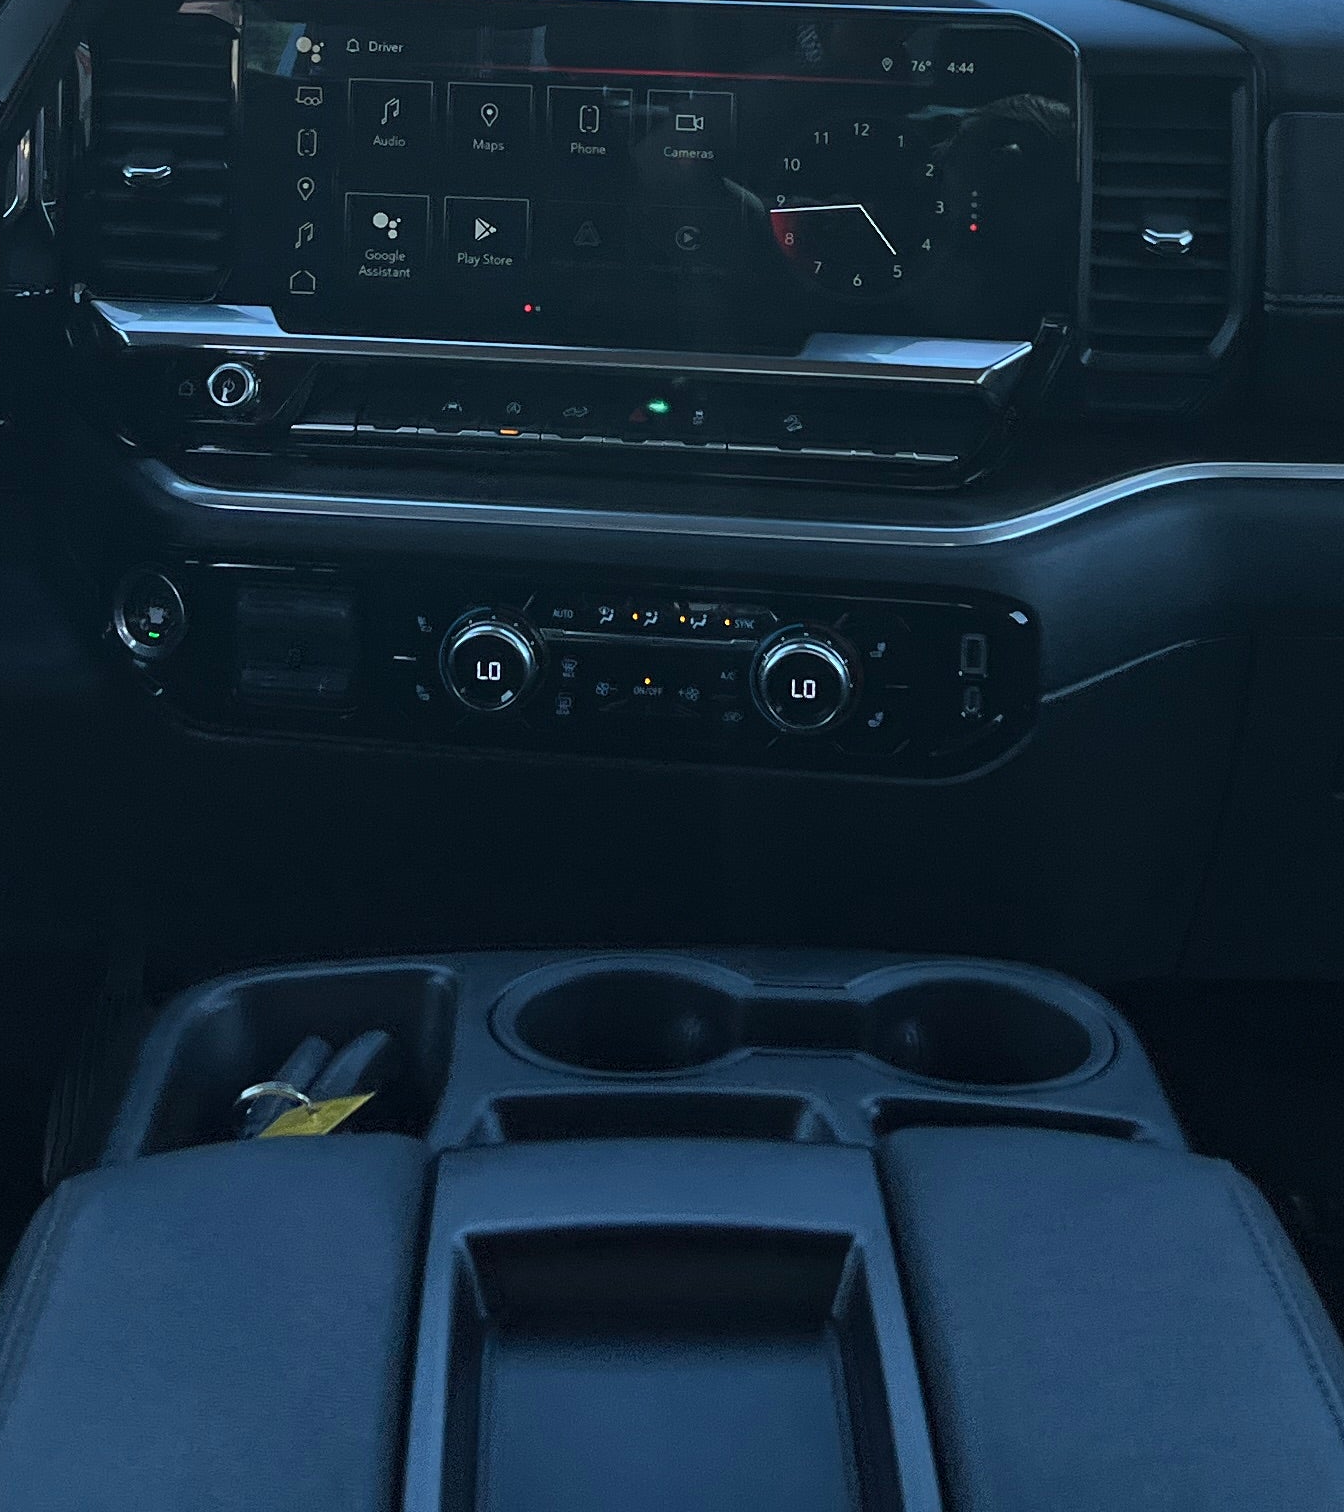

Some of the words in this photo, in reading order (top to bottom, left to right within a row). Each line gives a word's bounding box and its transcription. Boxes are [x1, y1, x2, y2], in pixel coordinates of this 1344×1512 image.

[368, 40, 403, 54] Driver
[947, 61, 976, 74] 4:44
[854, 122, 870, 137] 12
[372, 135, 406, 147] Audio
[814, 131, 830, 145] 11
[897, 135, 905, 148] 1
[473, 138, 505, 153] Maps
[570, 142, 606, 155] Phone
[663, 146, 715, 160] Cameras
[783, 157, 801, 171] 10
[925, 164, 935, 178] 2
[776, 195, 786, 208] 9
[935, 201, 944, 215] 3
[785, 232, 794, 245] 8
[921, 238, 931, 251] 4
[364, 249, 406, 264] Google
[457, 252, 481, 268] Play
[483, 253, 513, 267] Store
[358, 265, 411, 279] Assistant
[814, 261, 823, 274] 7
[893, 264, 902, 278] 5
[853, 273, 862, 287] 6
[552, 608, 574, 619] AUTO
[734, 619, 755, 630] SYNC
[476, 661, 501, 681] LO
[633, 687, 664, 697] ON/OFF
[791, 678, 816, 699] LO
